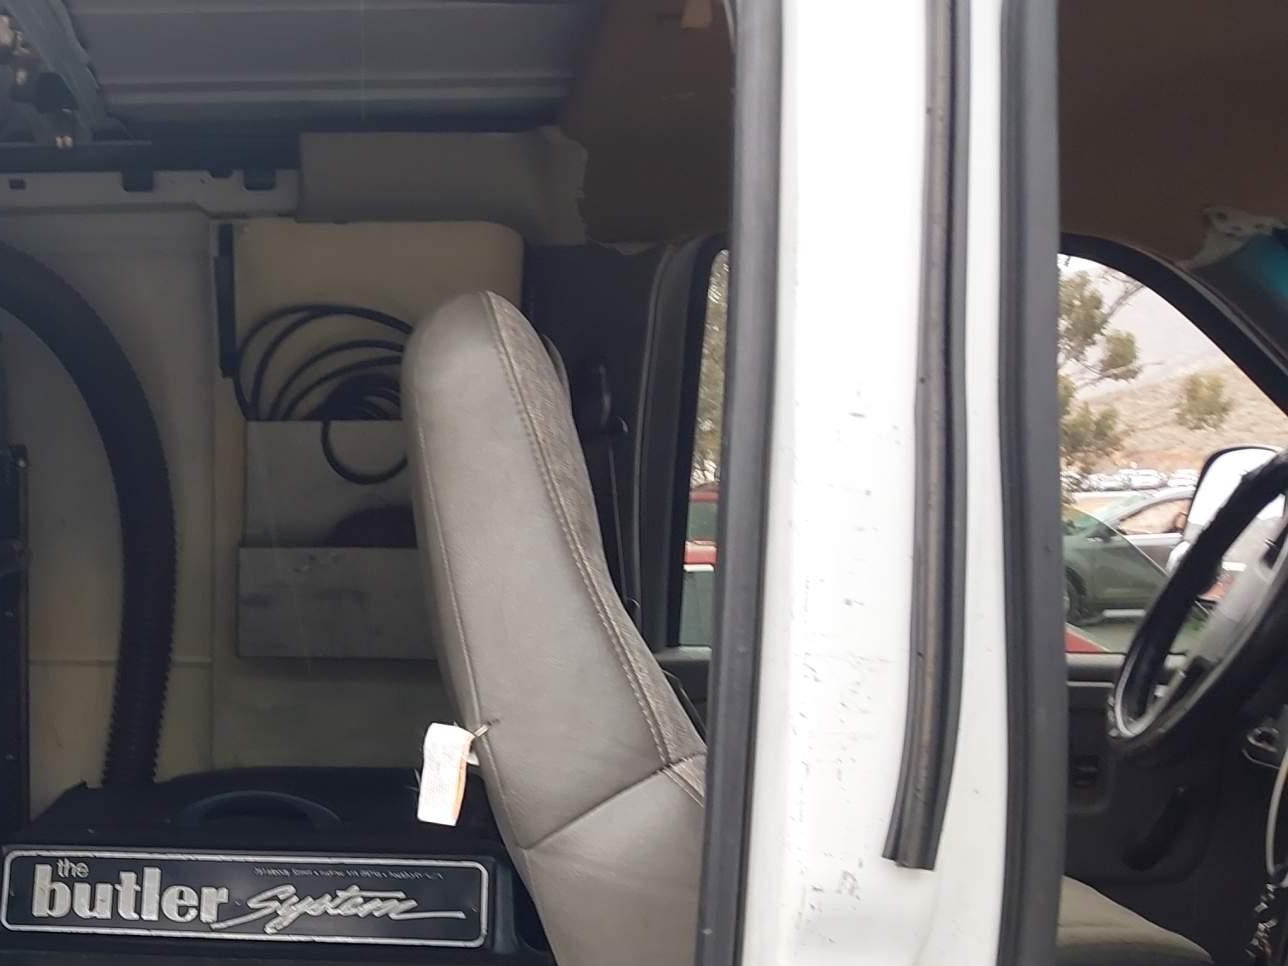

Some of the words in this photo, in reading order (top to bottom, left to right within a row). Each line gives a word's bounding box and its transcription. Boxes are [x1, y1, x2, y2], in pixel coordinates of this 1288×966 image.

[56, 858, 90, 879] the
[32, 863, 229, 925] butler
[211, 884, 467, 936] System
